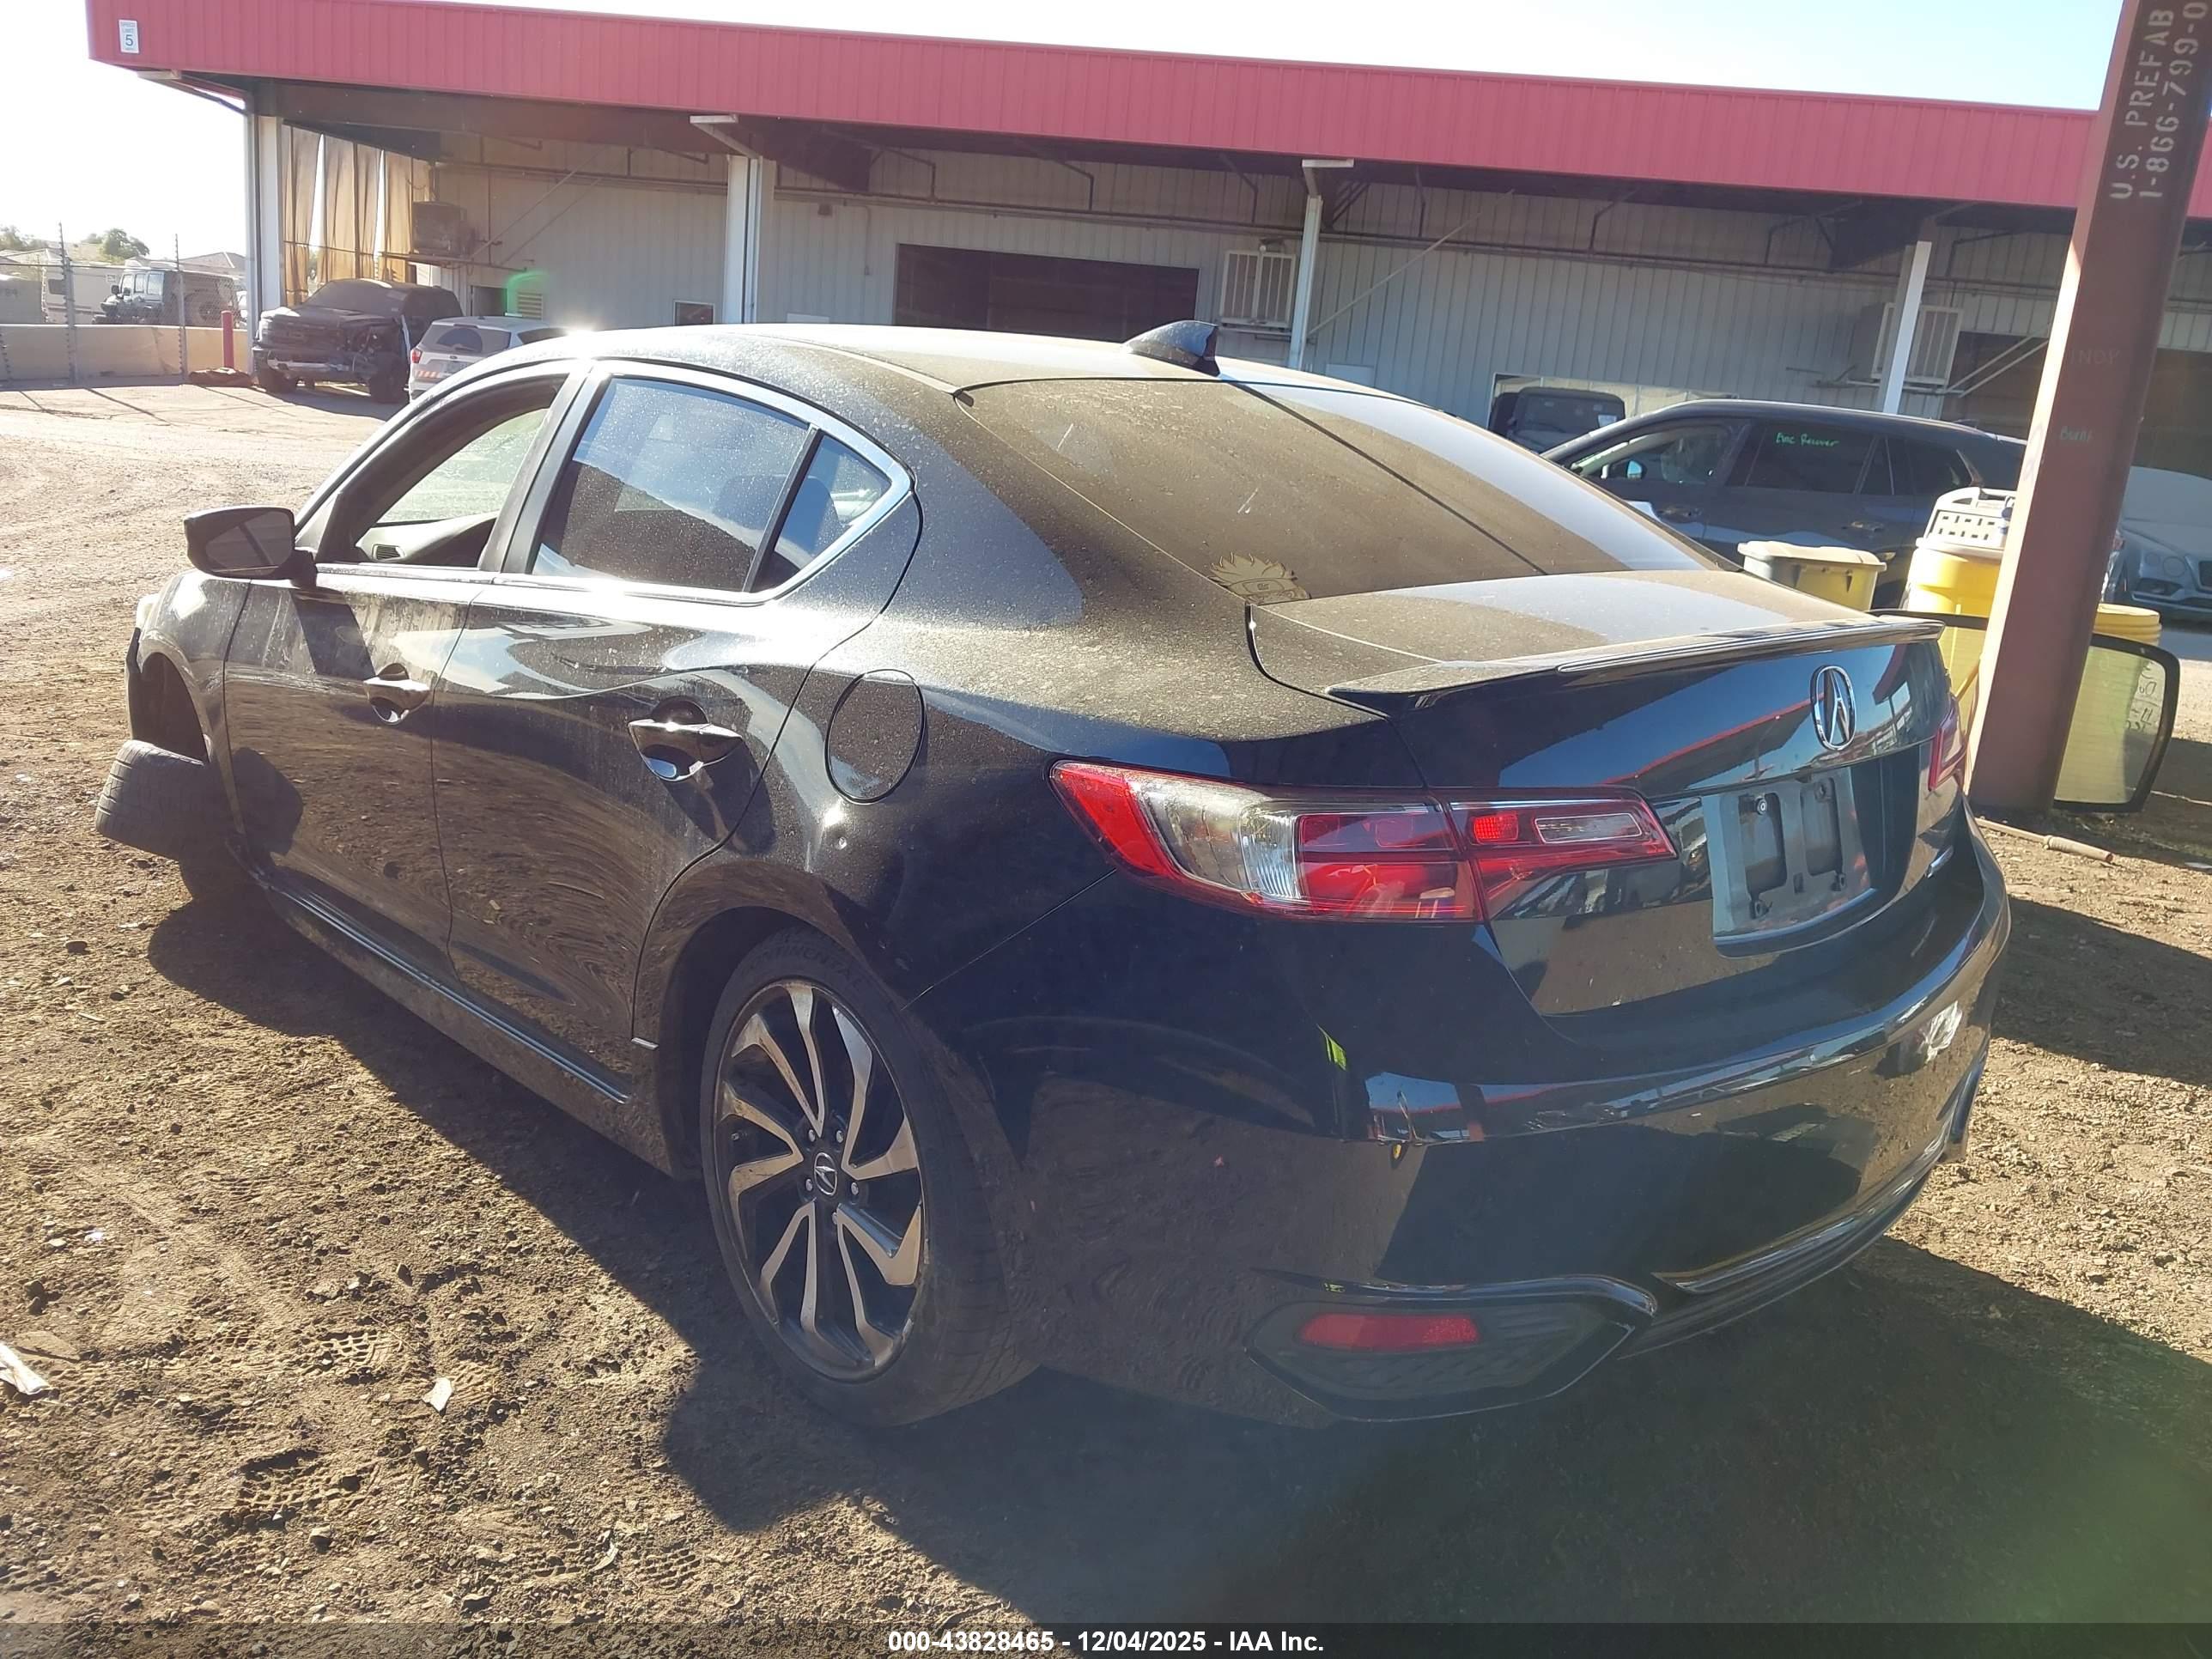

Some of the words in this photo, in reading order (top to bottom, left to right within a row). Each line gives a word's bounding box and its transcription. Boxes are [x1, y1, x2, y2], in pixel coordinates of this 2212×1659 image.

[125, 33, 134, 46] 5
[2124, 9, 2174, 126] PREFAB
[2109, 145, 2142, 199] U.S.
